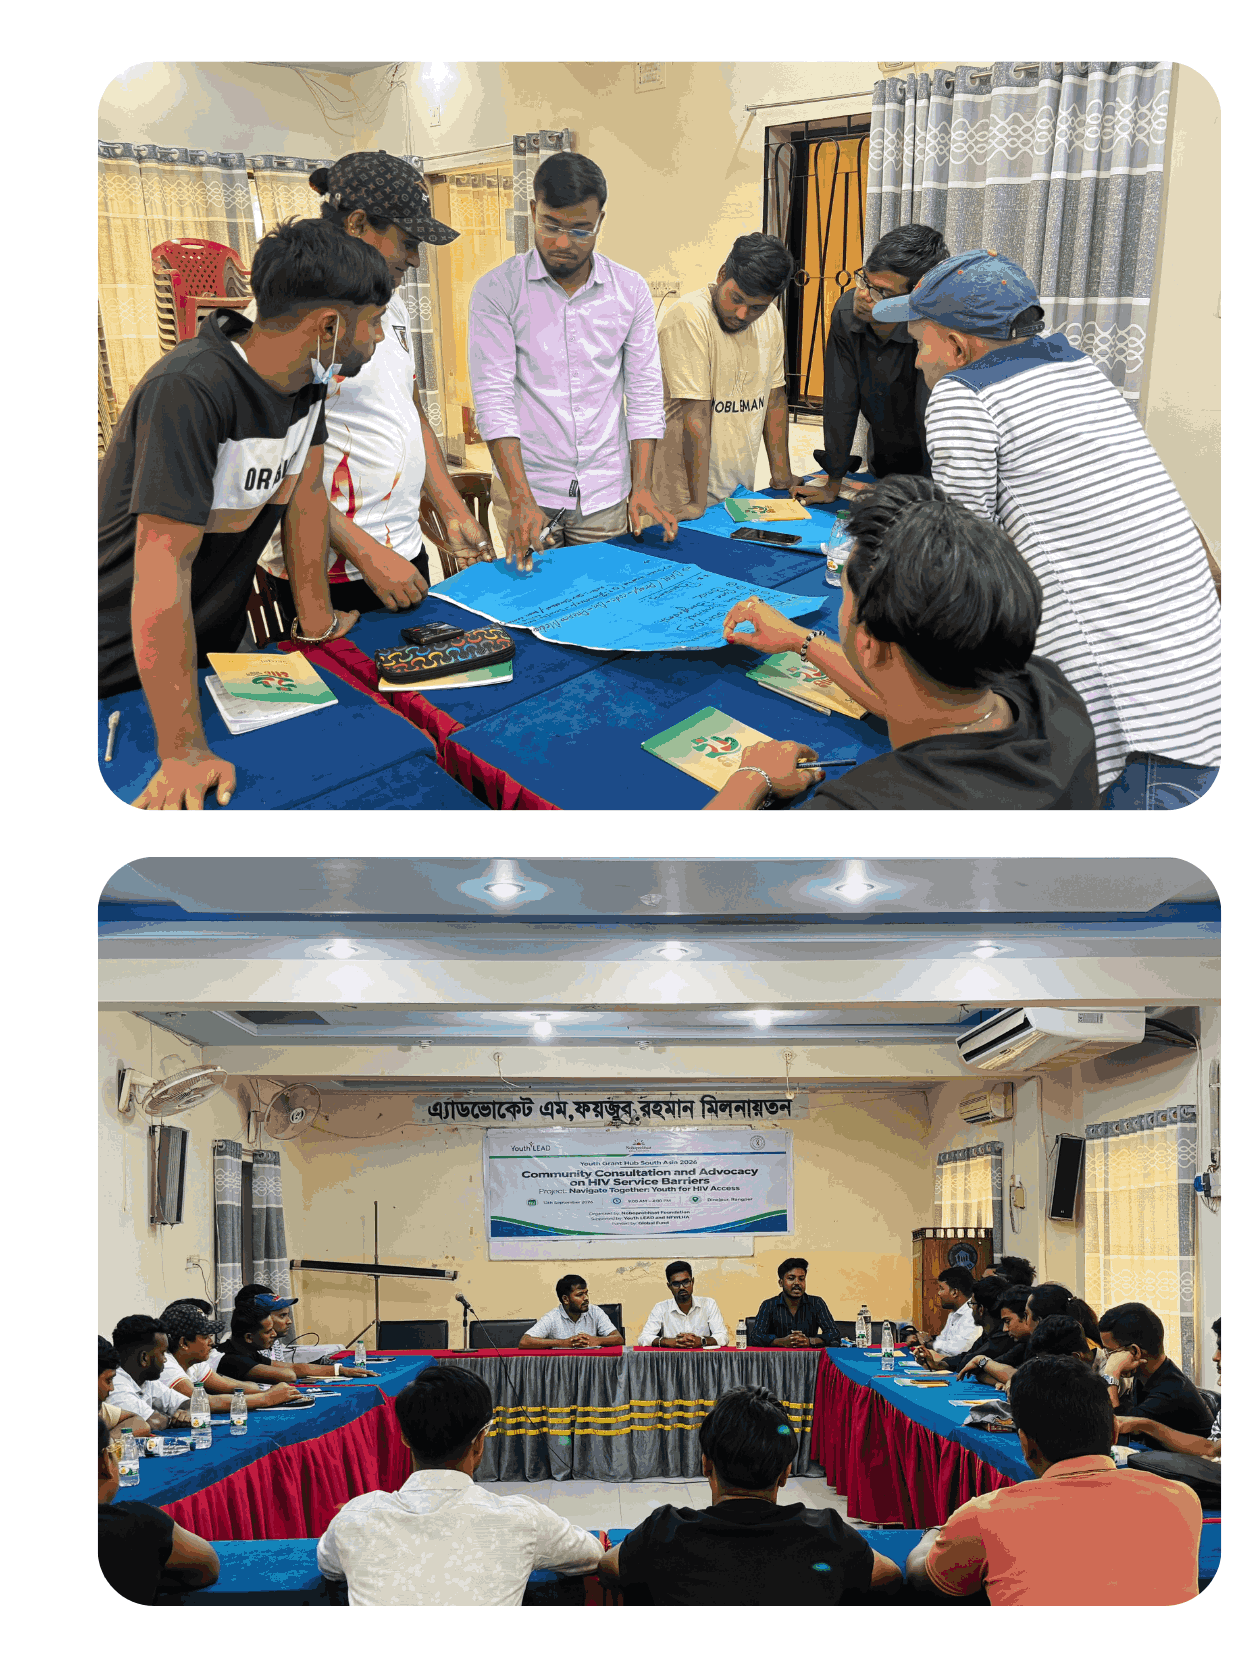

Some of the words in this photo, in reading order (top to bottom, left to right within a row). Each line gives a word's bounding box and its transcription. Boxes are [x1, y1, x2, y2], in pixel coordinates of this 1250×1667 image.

[700, 1095, 793, 1119] মিলনায়তন
[521, 1170, 592, 1179] Community
[595, 1168, 671, 1177] Consultation
[673, 1168, 696, 1176] and
[699, 1167, 759, 1177] Advocacy
[613, 1177, 659, 1186] Service
[661, 1177, 710, 1185] Barriers
[539, 1188, 567, 1196] Project:
[569, 1187, 608, 1195] Navigate
[609, 1186, 650, 1195] Together:
